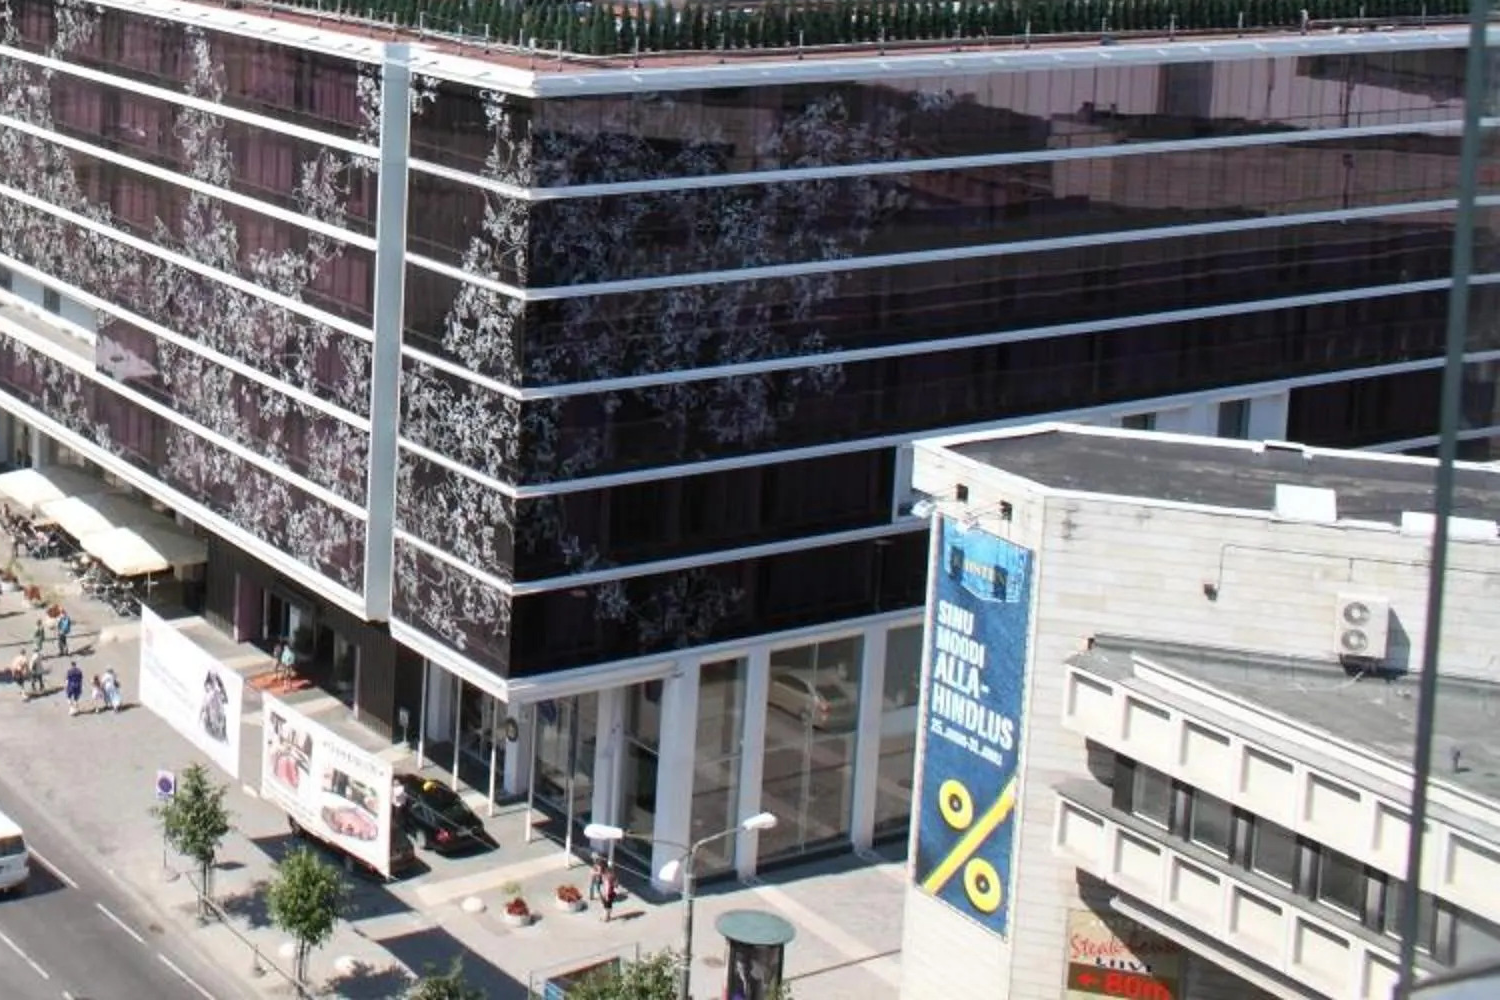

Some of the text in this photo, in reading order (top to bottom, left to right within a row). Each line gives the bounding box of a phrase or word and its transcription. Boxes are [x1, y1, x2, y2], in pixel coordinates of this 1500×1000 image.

[937, 600, 975, 635] SINU
[936, 625, 986, 669] MOODI
[934, 652, 990, 699] ALLA-
[931, 682, 1014, 751] HINDLUS
